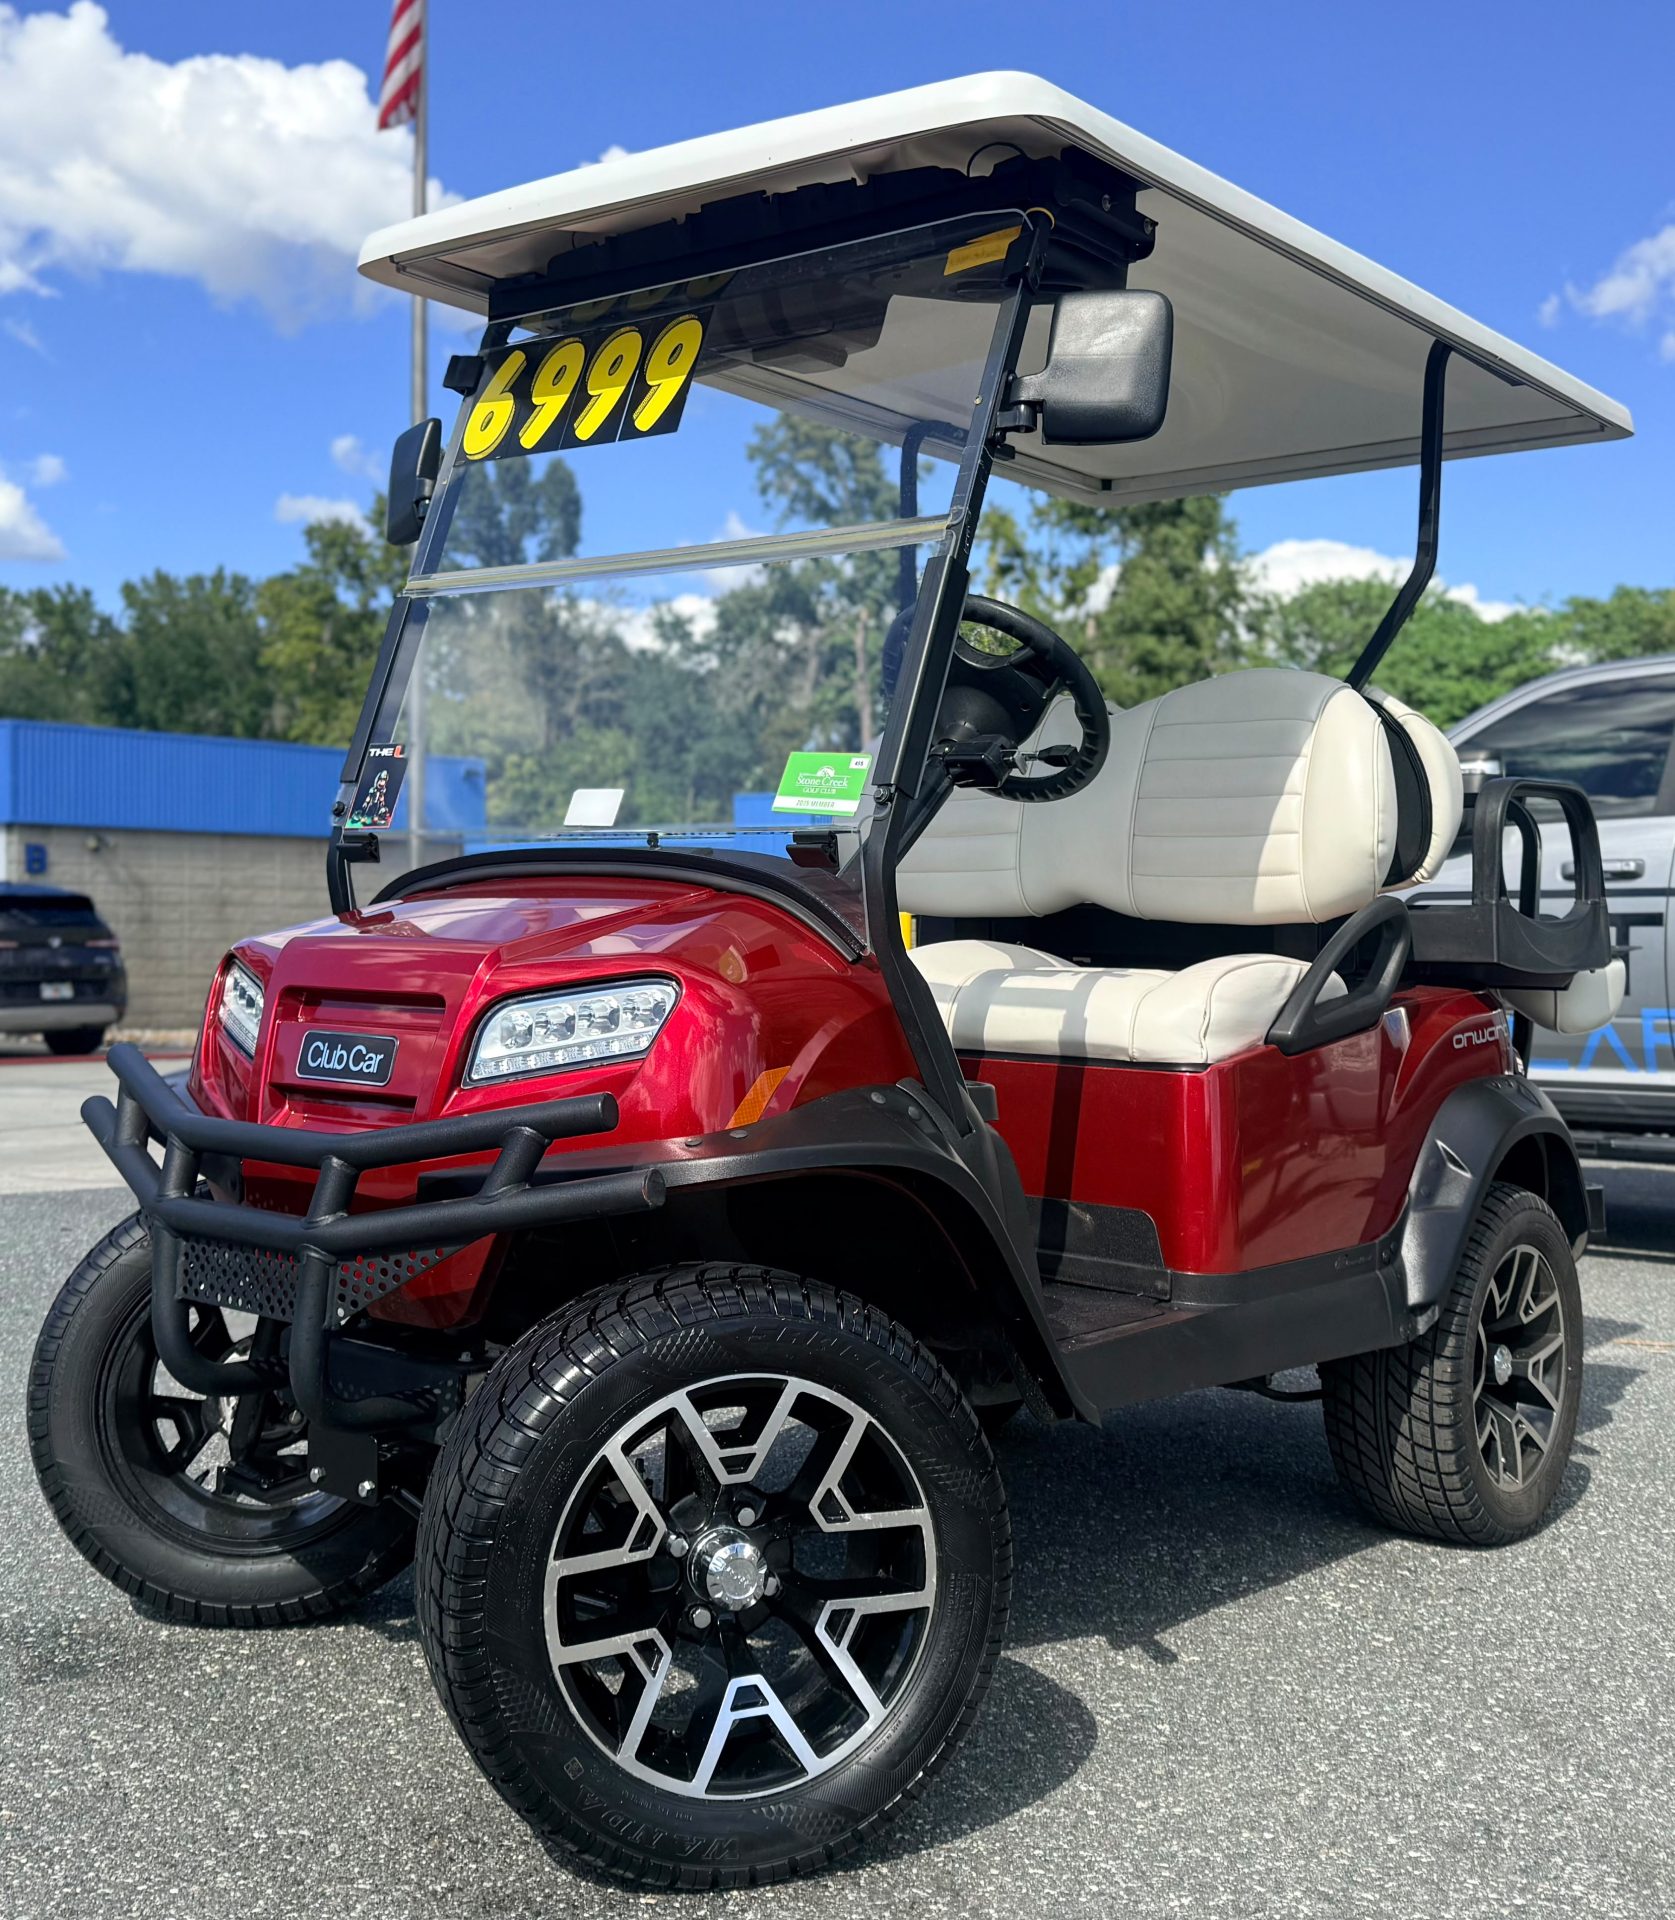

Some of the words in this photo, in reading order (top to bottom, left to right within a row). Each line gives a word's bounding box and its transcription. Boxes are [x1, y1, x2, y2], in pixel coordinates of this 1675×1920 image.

[463, 314, 703, 460] 6999
[369, 747, 394, 757] THE
[797, 775, 820, 785] Stone
[822, 776, 848, 787] Creek
[25, 843, 48, 874] B
[307, 1041, 347, 1070] Club
[348, 1044, 384, 1074] Car
